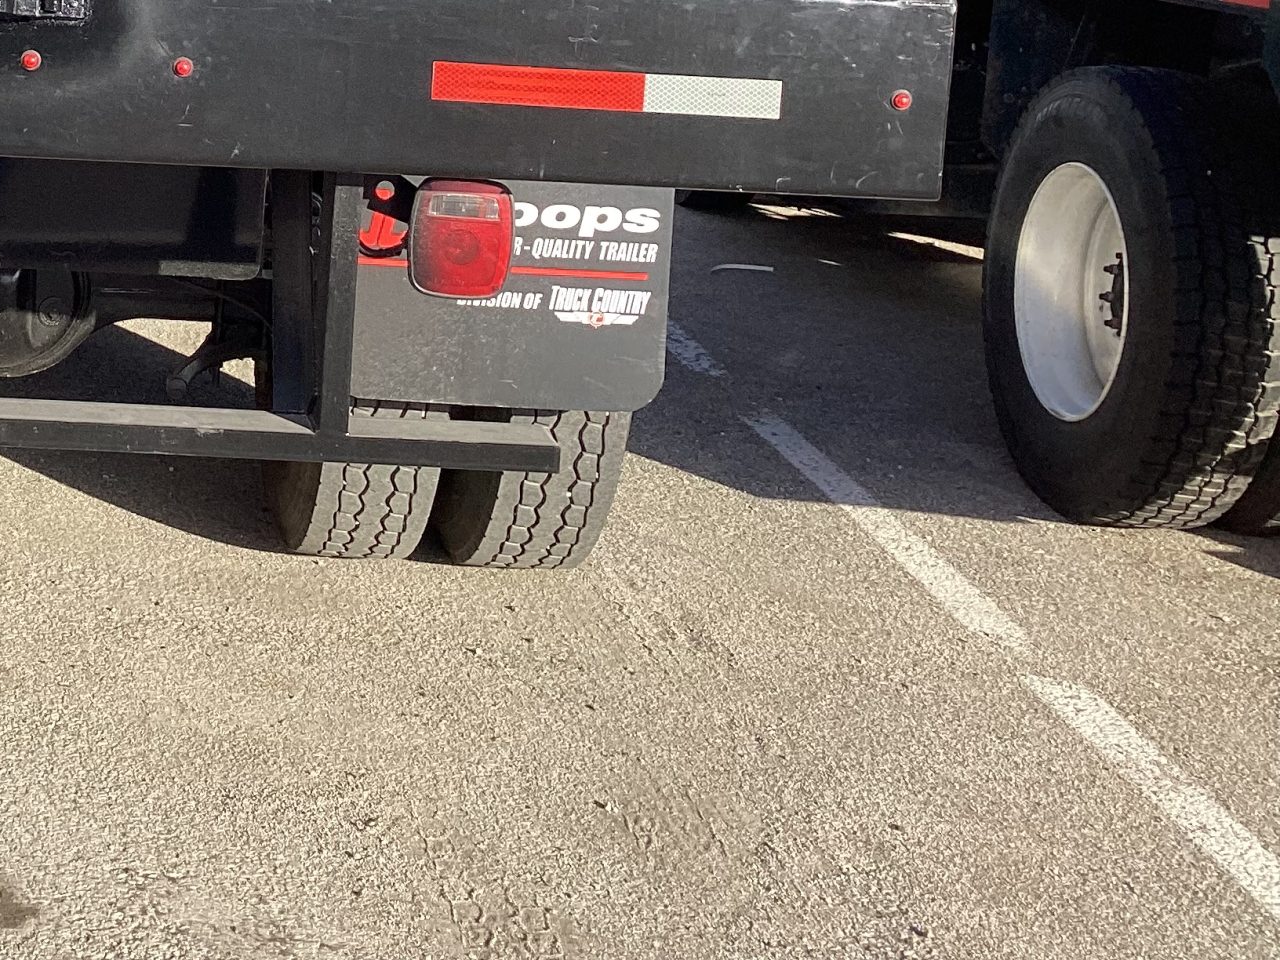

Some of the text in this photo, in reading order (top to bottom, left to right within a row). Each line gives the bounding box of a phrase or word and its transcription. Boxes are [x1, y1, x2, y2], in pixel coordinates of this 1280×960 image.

[598, 242, 659, 263] TRAILER
[523, 293, 544, 311] OF
[548, 285, 593, 312] TRUCK
[591, 287, 652, 315] COUNTRY
